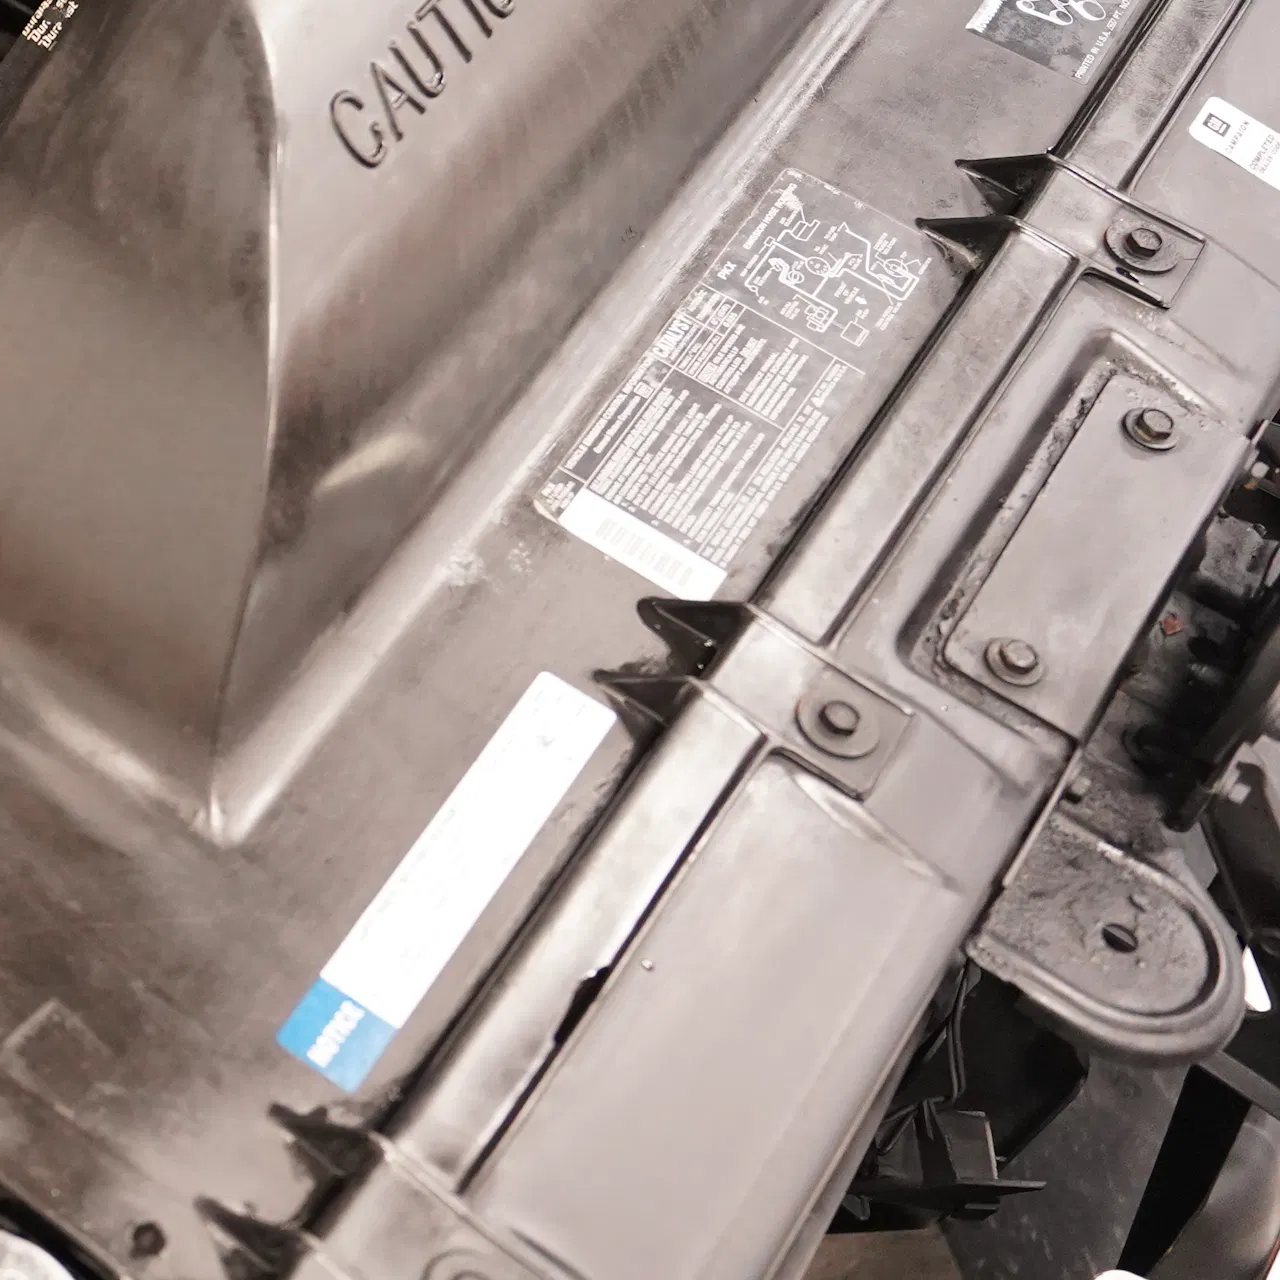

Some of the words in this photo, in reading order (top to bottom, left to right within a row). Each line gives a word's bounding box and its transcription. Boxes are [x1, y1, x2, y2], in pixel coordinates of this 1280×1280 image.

[1074, 53, 1095, 79] PRINTED
[1248, 133, 1275, 170] COMPLETED
[716, 259, 735, 281] PKX
[743, 220, 768, 251] EMISSION
[762, 205, 779, 224] HOSE
[654, 312, 692, 360] CATALYST
